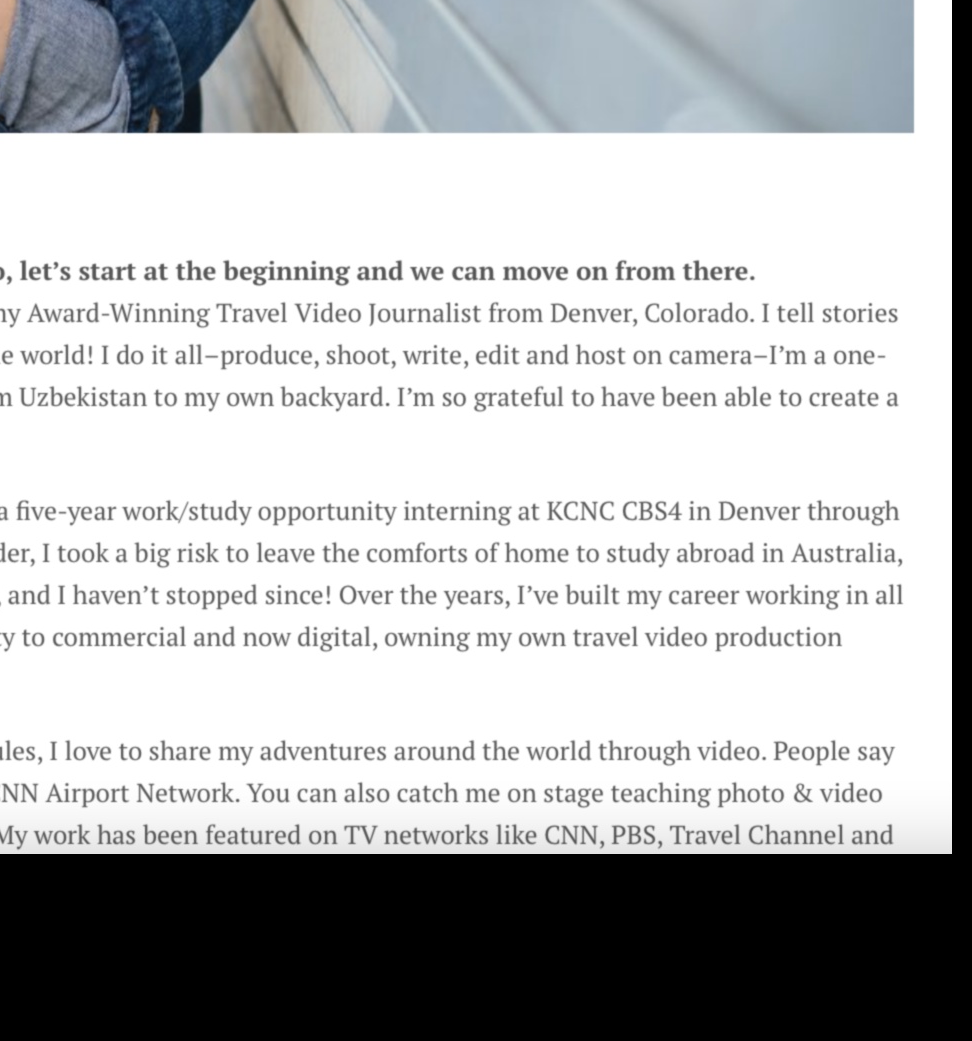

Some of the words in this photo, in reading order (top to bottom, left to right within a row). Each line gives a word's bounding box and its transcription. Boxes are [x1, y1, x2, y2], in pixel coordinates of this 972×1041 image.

[19, 259, 72, 282] let’s
[78, 262, 137, 282] start
[143, 262, 169, 282] at
[175, 259, 217, 282] the
[222, 259, 351, 287] beginning
[356, 259, 404, 282] and
[409, 265, 445, 282] we
[451, 265, 496, 282] can
[502, 265, 569, 282] move
[575, 265, 609, 282] on
[615, 259, 676, 282] from
[682, 259, 756, 282] there.
[26, 301, 211, 329] Award-Winning
[215, 301, 288, 324] Travel
[294, 301, 362, 324] Video
[368, 301, 482, 328] Journalist
[488, 301, 544, 324] from
[550, 302, 638, 328] Denver,
[644, 301, 755, 324] Colorado.
[761, 302, 770, 324] I
[776, 301, 815, 324] tell
[821, 301, 899, 324] stories
[42, 542, 50, 564] I
[56, 541, 110, 564] took
[115, 547, 128, 564] a
[134, 541, 172, 569] big
[176, 541, 220, 564] risk
[225, 544, 250, 564] to
[256, 541, 316, 564] leave
[321, 541, 360, 564] the
[366, 541, 468, 564] comforts
[474, 541, 501, 564] of
[504, 541, 570, 564] home
[575, 544, 600, 564] to
[606, 541, 671, 569] study
[676, 541, 755, 564] abroad
[761, 541, 785, 564] in
[790, 541, 903, 568] Australia,
[21, 628, 46, 648] to
[52, 625, 187, 648] commercial
[193, 625, 236, 648] and
[242, 631, 292, 648] now
[297, 625, 378, 653] digital,
[384, 625, 471, 653] owning
[476, 631, 513, 653] my
[518, 631, 567, 648] own
[572, 625, 639, 648] travel
[644, 625, 708, 648] video
[714, 625, 843, 653] production
[33, 823, 91, 846] work
[96, 823, 136, 846] has
[142, 823, 199, 846] been
[205, 823, 302, 846] featured
[308, 829, 338, 846] on
[343, 824, 379, 846] TV
[383, 823, 489, 846] networks
[495, 823, 538, 846] like
[544, 824, 605, 850] CNN,
[611, 824, 663, 850] PBS,
[669, 823, 741, 846] Travel
[748, 823, 845, 846] Channel
[851, 823, 894, 846] and
